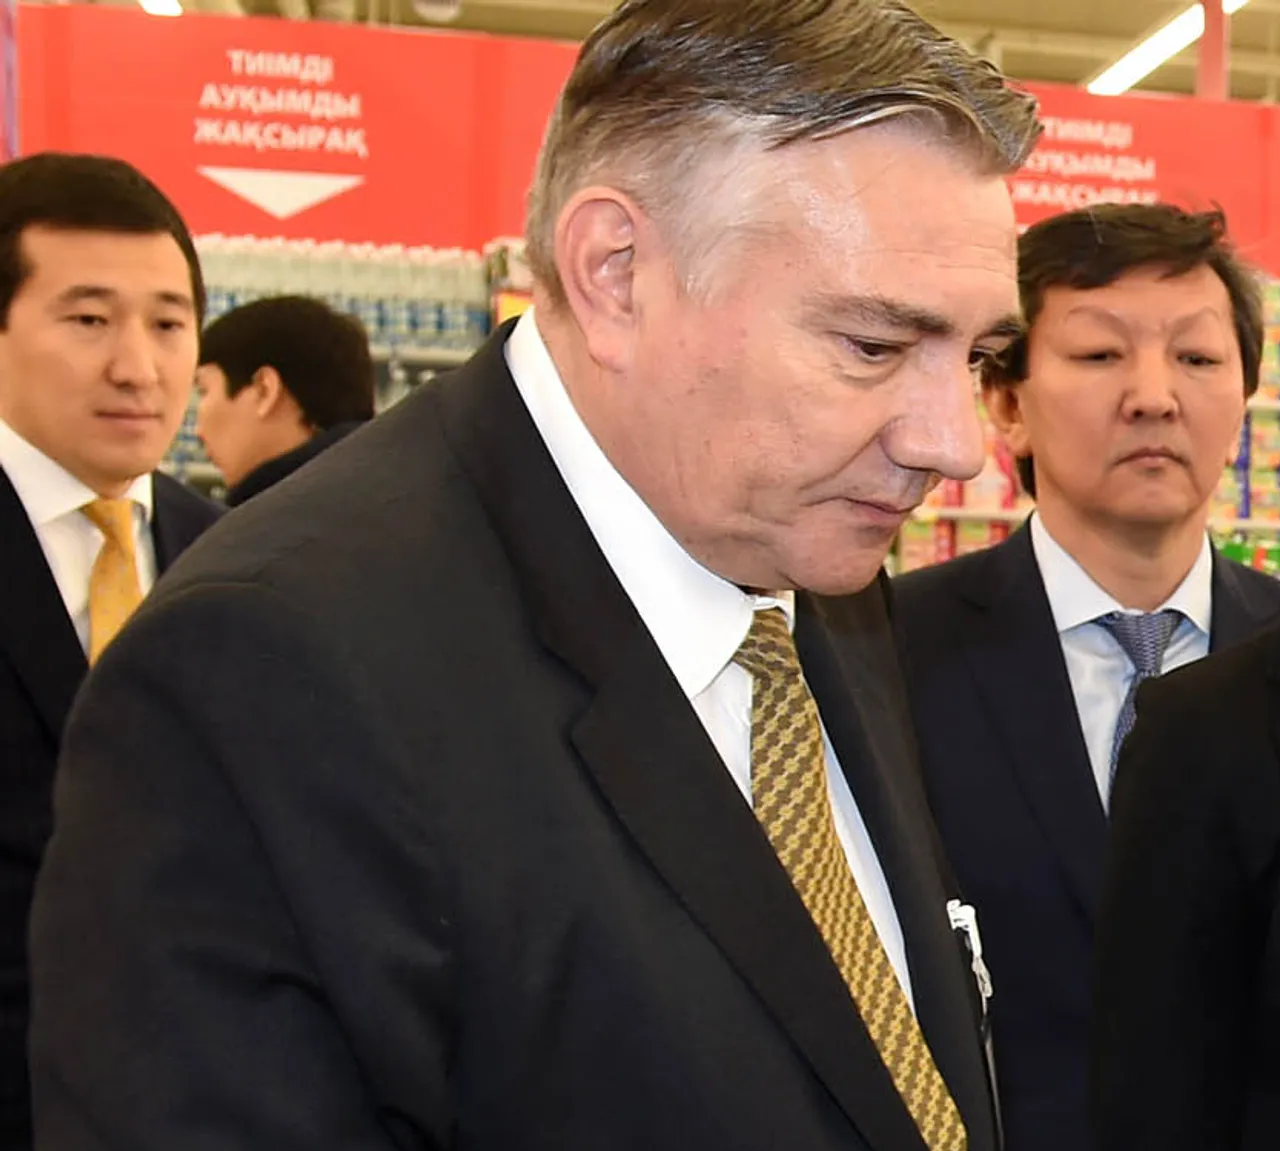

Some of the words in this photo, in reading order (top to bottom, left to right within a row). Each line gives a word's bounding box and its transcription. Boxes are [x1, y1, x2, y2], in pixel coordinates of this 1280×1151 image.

[226, 49, 334, 85] ТИІМДІ
[199, 81, 361, 121] АУҚЫМДЫ
[194, 117, 369, 160] ЖАҚСЫРАҚ
